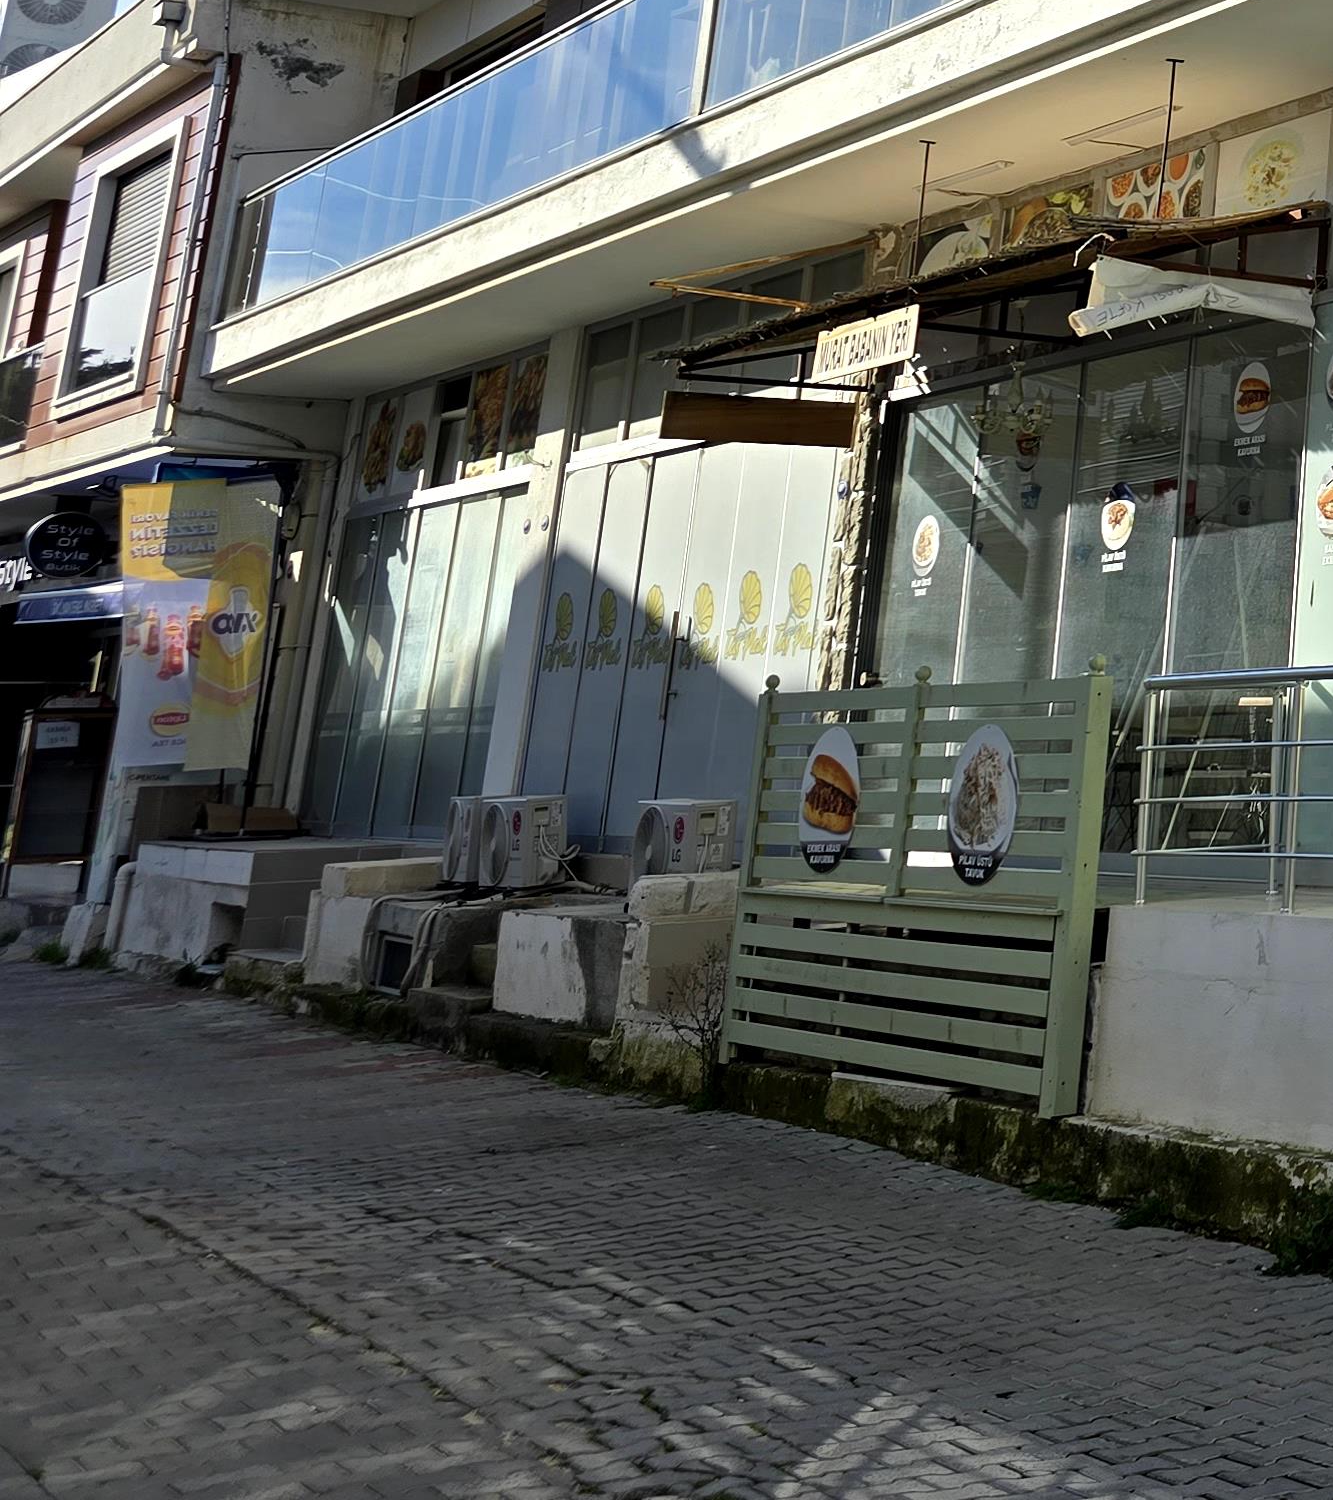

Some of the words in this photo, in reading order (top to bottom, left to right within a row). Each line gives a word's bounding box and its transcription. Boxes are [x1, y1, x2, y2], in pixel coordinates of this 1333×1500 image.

[47, 524, 95, 536] Style
[57, 537, 79, 546] Of
[41, 549, 89, 562] Style
[512, 839, 520, 850] LG
[671, 849, 681, 862] LG
